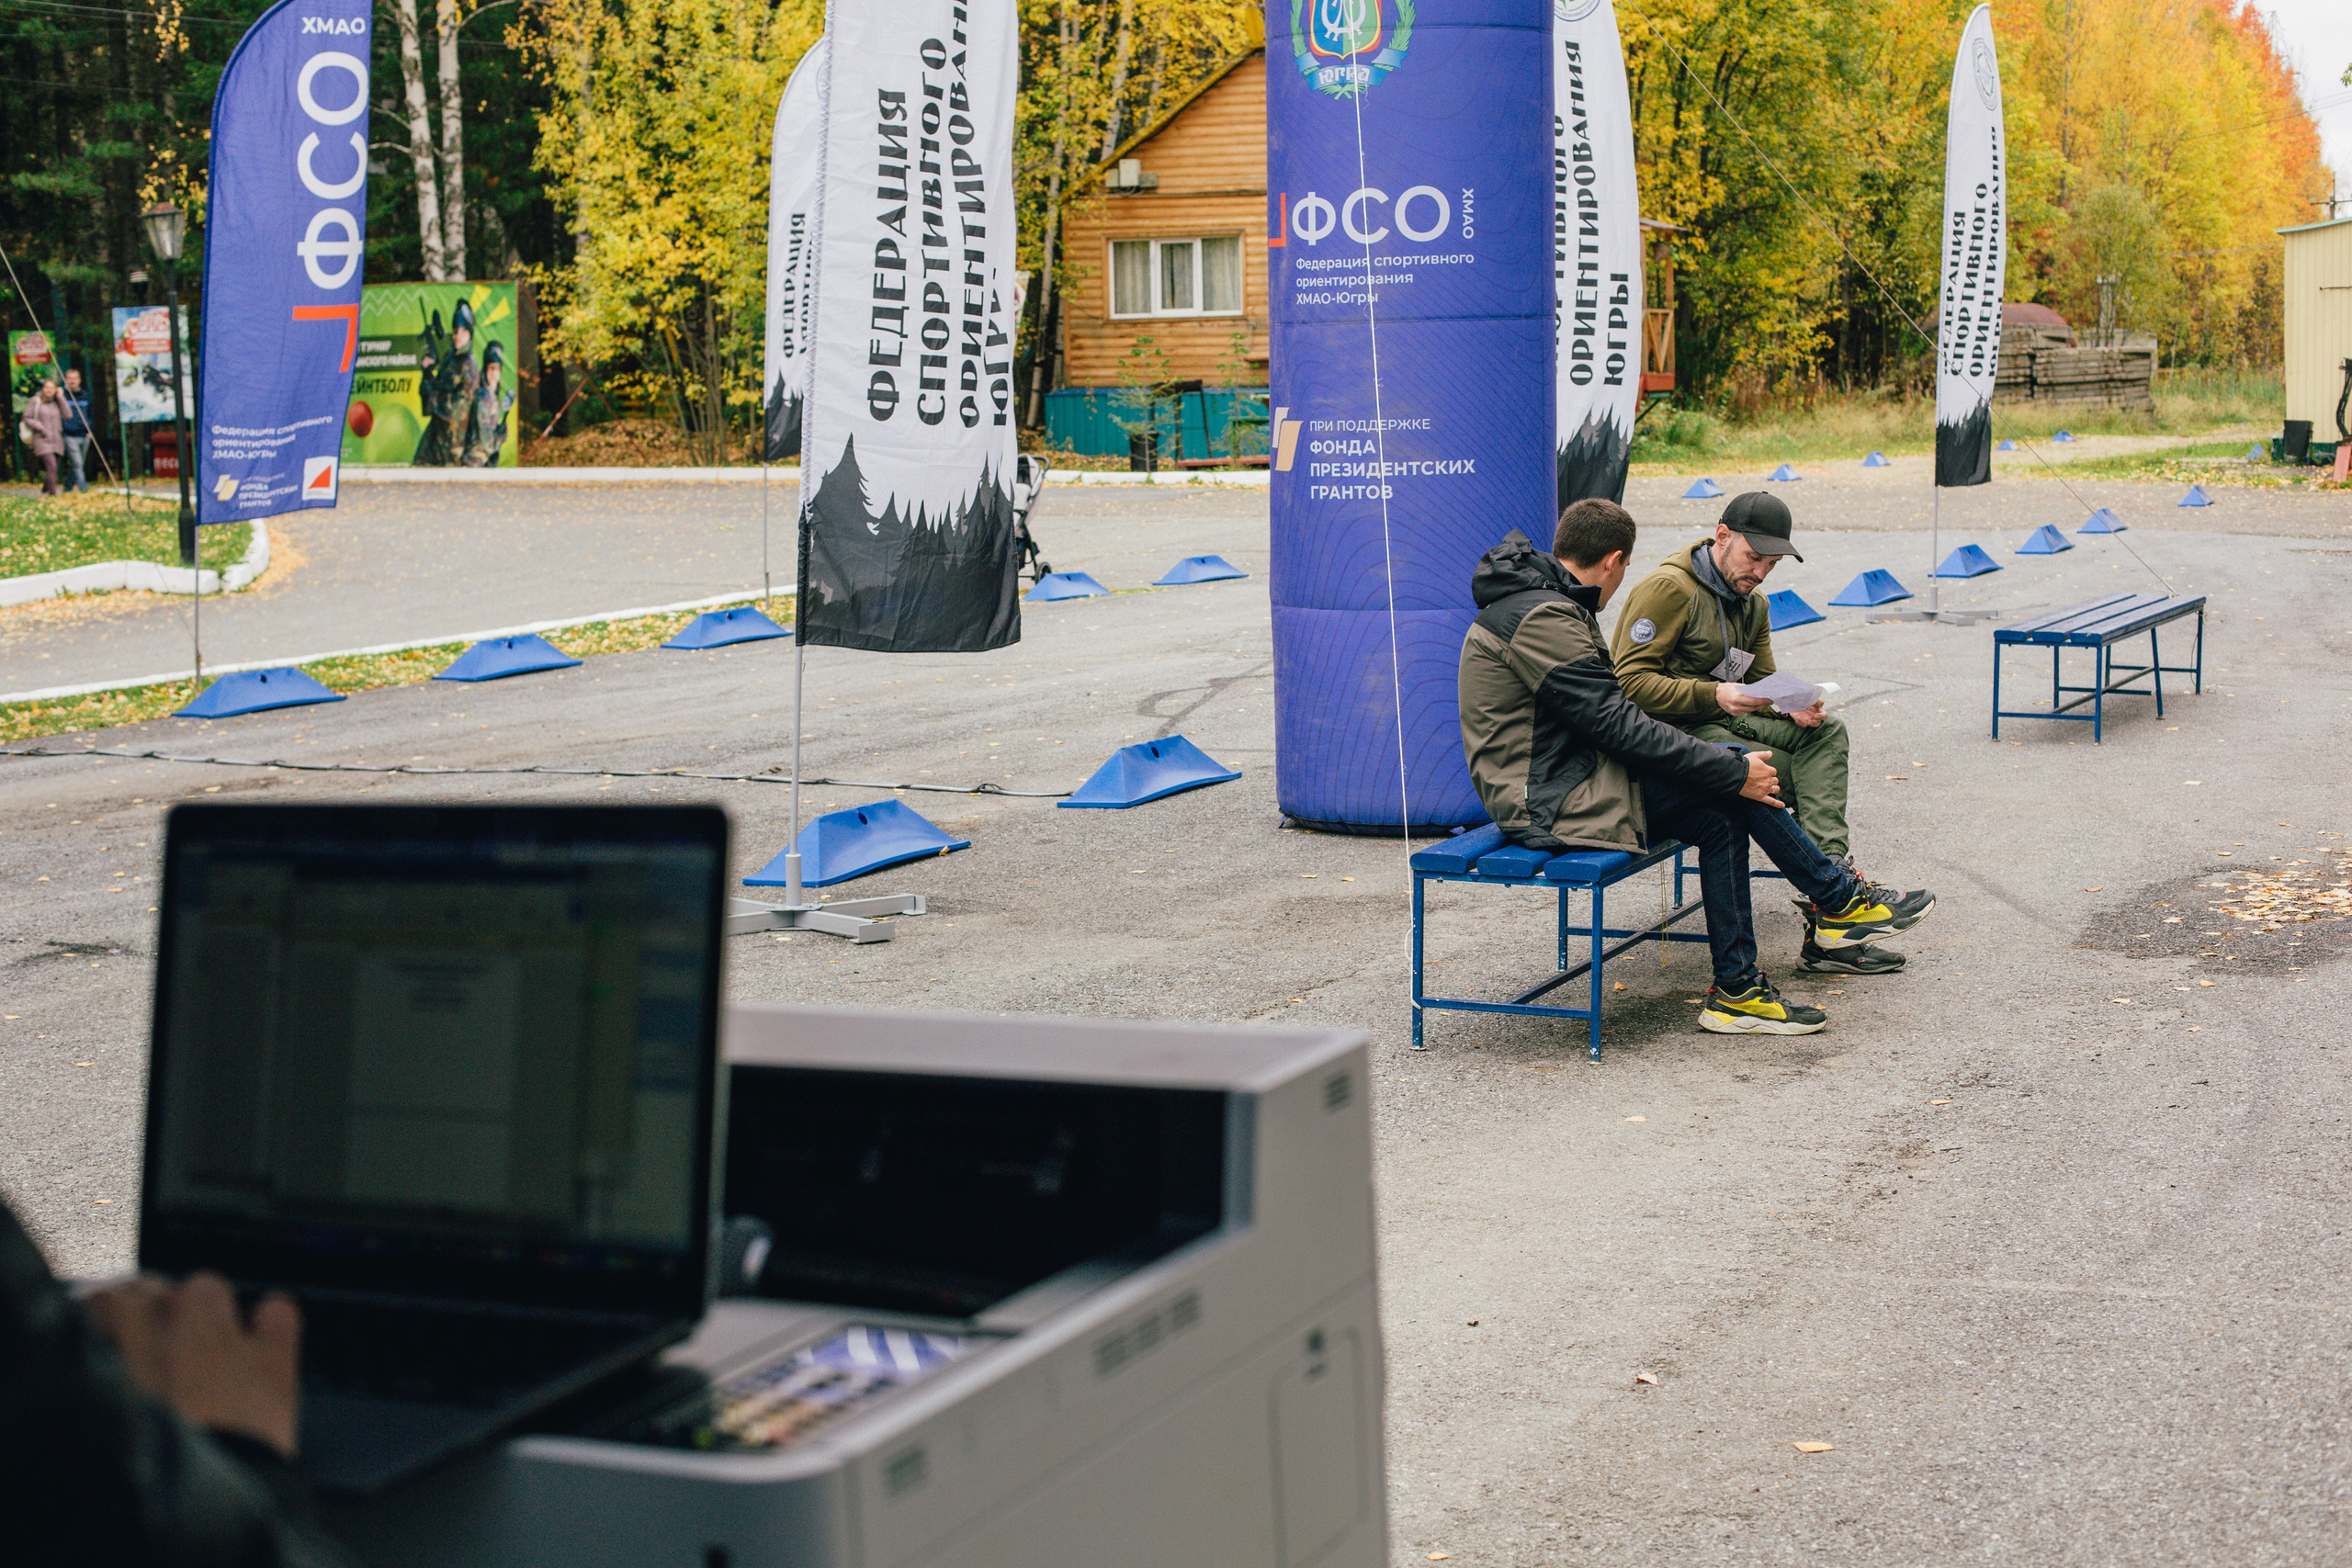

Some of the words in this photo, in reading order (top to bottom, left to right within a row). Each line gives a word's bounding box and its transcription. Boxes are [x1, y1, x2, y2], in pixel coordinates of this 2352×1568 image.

[301, 17, 367, 36] ХМАО
[297, 51, 368, 290] ФСО
[917, 38, 950, 425] СПОРТИВНОГО
[948, 0, 986, 428] ОРИЕНТИРОВАН
[1292, 185, 1451, 246] ФСО
[1462, 187, 1475, 240] ХМАО
[1565, 39, 1600, 386] ОРИЕНТИРОВАНИЯ
[867, 88, 910, 422] ФЕДЕРАЦИЯ
[1295, 257, 1369, 271] Федерация
[1374, 254, 1475, 268] спортивного
[1951, 183, 1987, 376] СПОРТИВНОГО
[1969, 126, 2000, 377] ОРИЕНТИРОВАНИЯ
[783, 213, 806, 358] ФЕДЕРАЦИЯ
[1295, 273, 1414, 289] ориентирования
[1296, 291, 1378, 306] ХМАО-Югры
[1603, 273, 1629, 386] ЮГРЫ
[211, 424, 276, 437] Федерация
[1309, 421, 1333, 432] ПРИ
[1338, 418, 1431, 434] ПОДДЕРЖКЕ
[1309, 439, 1376, 457] ФОНДА
[1310, 459, 1476, 479] ПРЕЗИДЕНТСКИХ
[1310, 484, 1394, 500] ГРАНТОВ
